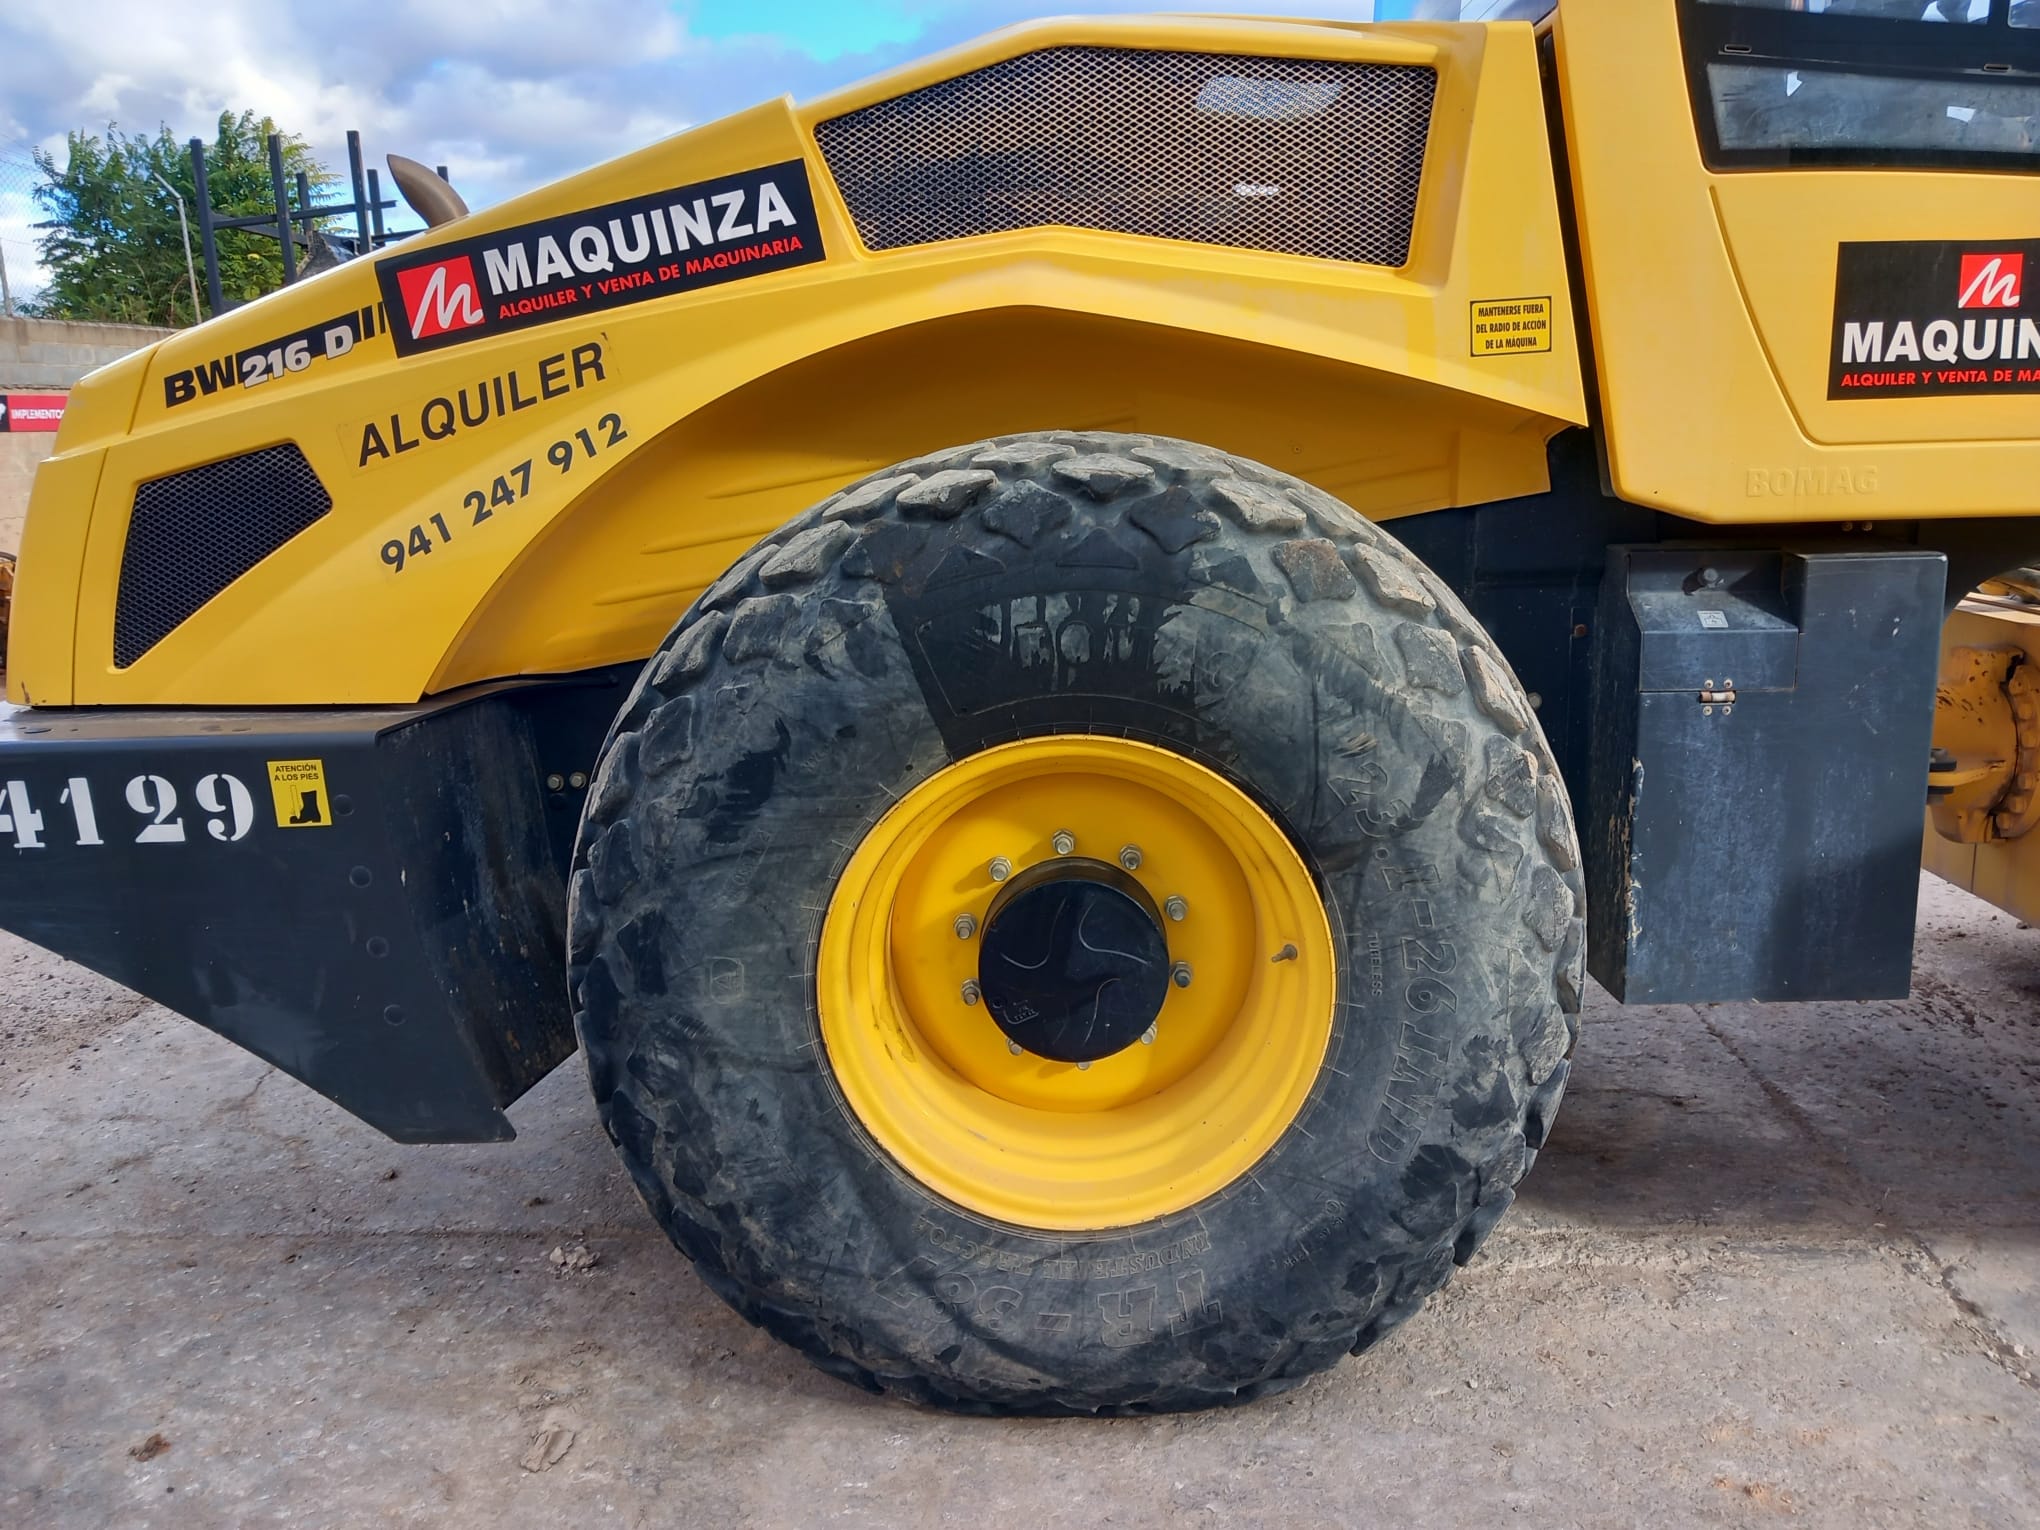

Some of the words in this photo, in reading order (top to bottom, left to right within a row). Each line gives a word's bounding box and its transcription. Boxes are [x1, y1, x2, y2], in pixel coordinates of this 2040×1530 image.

[482, 181, 798, 295] MAQUINZA
[499, 288, 578, 320] ALQUILER
[580, 285, 593, 300] Y
[598, 271, 653, 296] VENTA
[659, 264, 681, 282] DE
[686, 236, 803, 275] MAQUINARIA
[1476, 324, 1488, 333] DEL
[1490, 322, 1510, 333] RADIO
[1512, 321, 1520, 331] DE
[1478, 305, 1521, 317] MANTENERSE
[1523, 304, 1544, 314] FUERA
[324, 324, 354, 360] D
[1485, 339, 1494, 349] DE
[1496, 338, 1503, 348] LA
[1841, 372, 1916, 387] ALQUILER
[1922, 372, 1933, 384] Y
[1937, 370, 1987, 383] VENTA
[1994, 370, 2012, 382] DE
[359, 342, 606, 468] ALQUILER
[380, 512, 452, 574] 941
[463, 458, 533, 528] 247
[546, 413, 628, 475] 912
[1745, 465, 1878, 498] BOMAG
[275, 763, 317, 773] ATENCIÓN
[282, 773, 298, 781] LOS
[300, 772, 319, 780] PIES
[1042, 1230, 1213, 1280] INDUSTRAL
